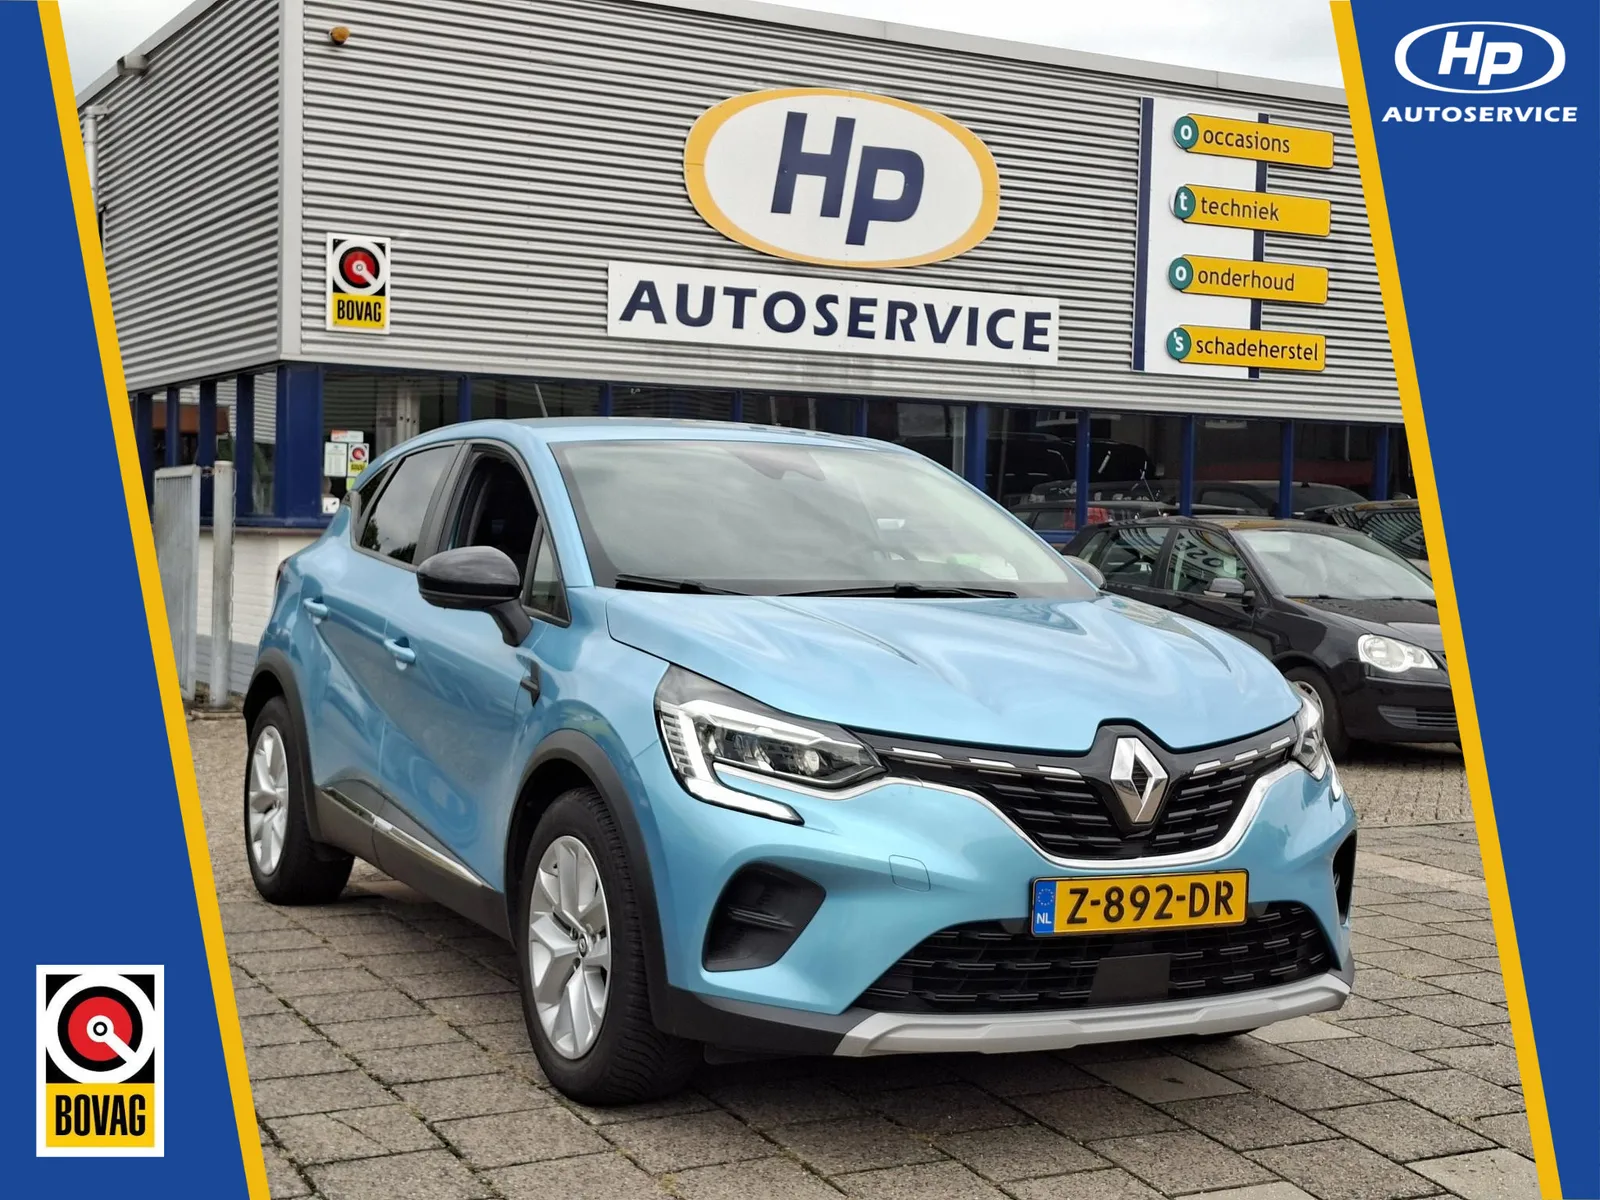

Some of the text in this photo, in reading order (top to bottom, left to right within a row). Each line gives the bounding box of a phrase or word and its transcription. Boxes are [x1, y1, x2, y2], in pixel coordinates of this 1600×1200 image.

[1180, 125, 1290, 153] o occasions
[771, 111, 924, 245] Hp
[1179, 193, 1279, 221] t techniek
[1175, 266, 1294, 292] o onderhoud
[337, 299, 382, 322] BOVAG
[619, 280, 1052, 352] AUTOSERVICE
[1196, 336, 1319, 361] schadeherstel
[1066, 880, 1234, 925] Z-892-DR
[1036, 912, 1052, 924] NL
